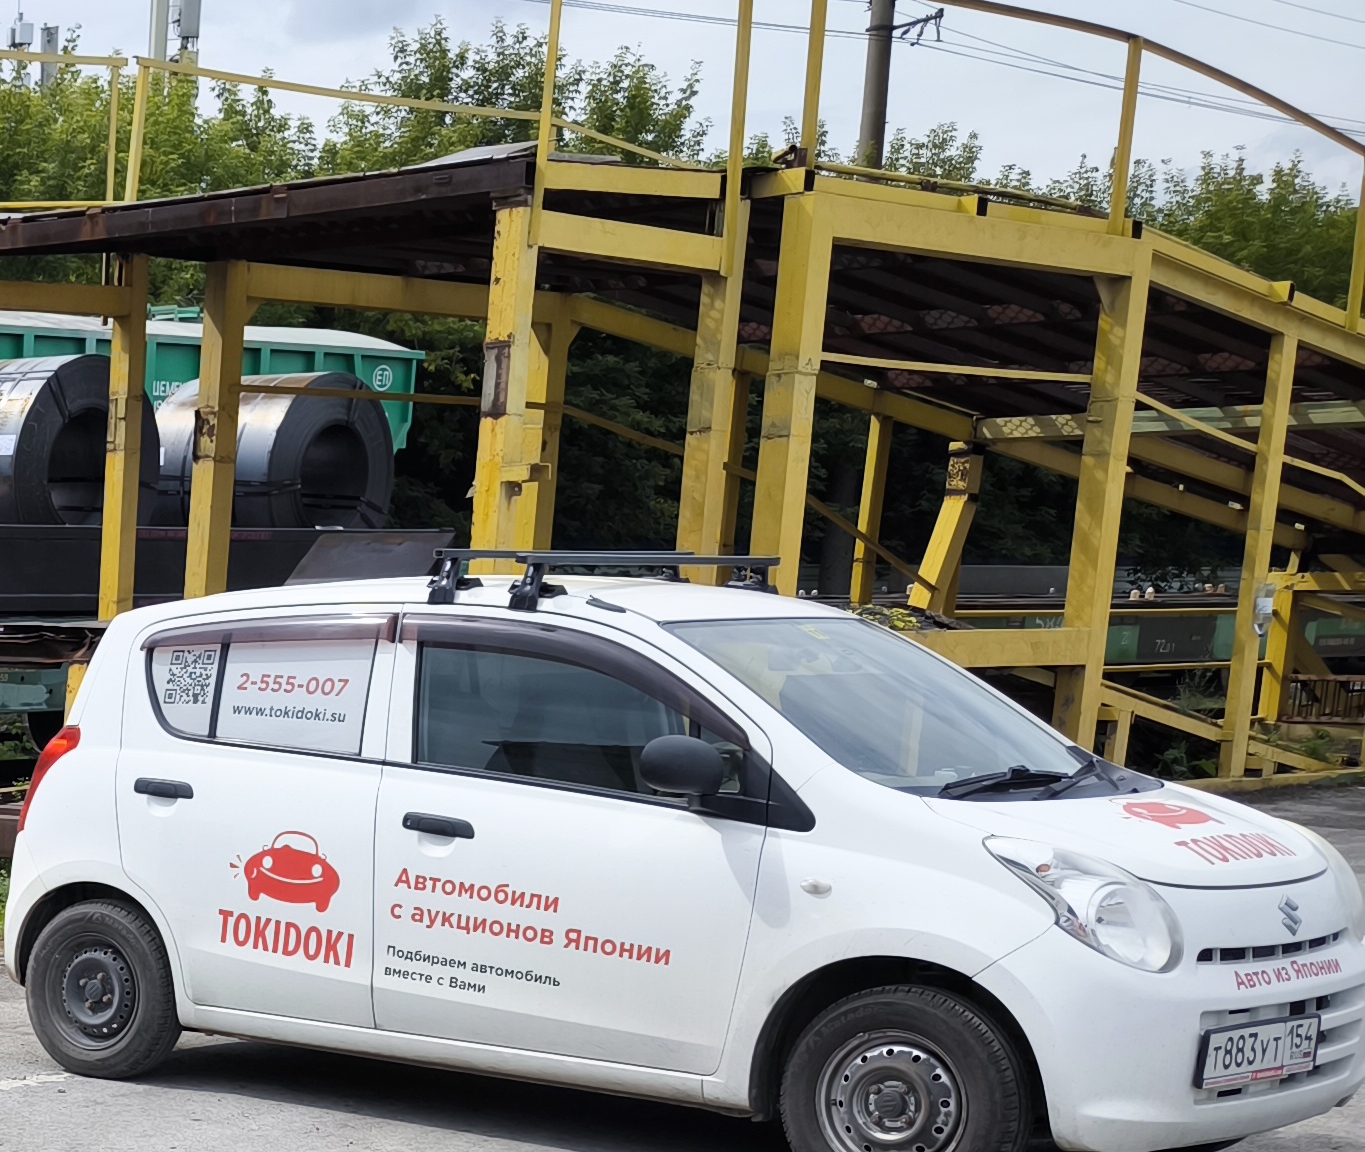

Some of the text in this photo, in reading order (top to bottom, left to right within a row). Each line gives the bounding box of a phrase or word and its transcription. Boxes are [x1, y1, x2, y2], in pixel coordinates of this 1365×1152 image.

[236, 672, 350, 697] 2-555-007
[232, 703, 347, 723] www.tokidoki.su
[1173, 831, 1297, 866] TOKIDOKI
[394, 867, 560, 914] Автомобили
[218, 908, 356, 969] TOKIDOKI
[390, 902, 671, 967] с аукционов Японии
[383, 966, 486, 994] вместе с Вами
[386, 945, 561, 988] Подбираем автомобиль
[1234, 958, 1343, 991] Авто из Японии
[1287, 1021, 1314, 1051] 154
